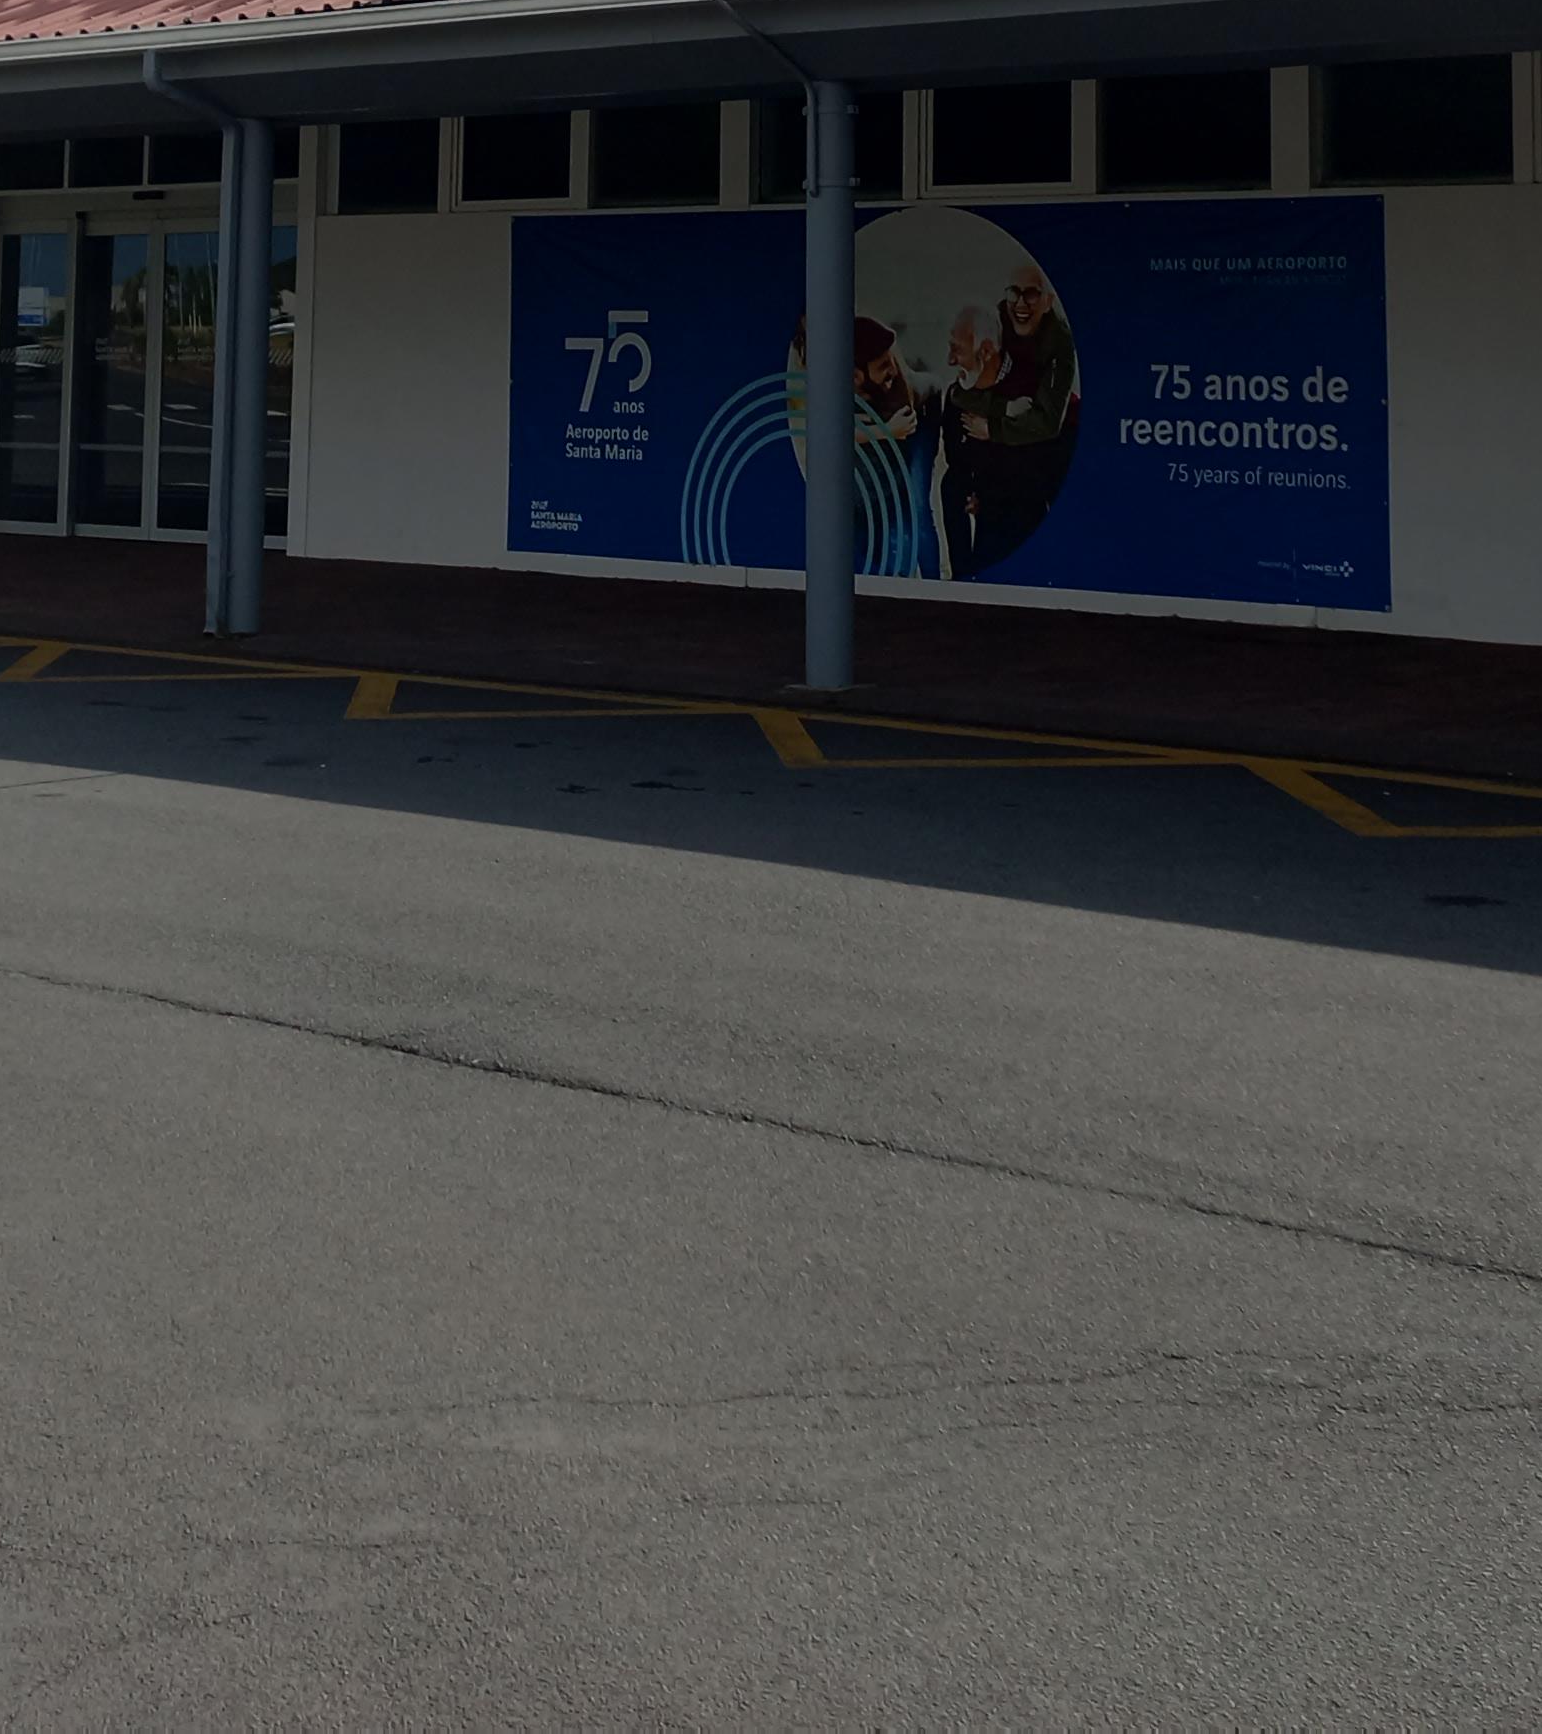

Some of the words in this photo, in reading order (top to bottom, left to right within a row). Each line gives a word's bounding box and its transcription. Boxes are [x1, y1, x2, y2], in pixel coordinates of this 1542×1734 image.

[1149, 257, 1187, 271] MAIS
[1191, 257, 1221, 272] QUE
[1226, 257, 1252, 270] UM
[1257, 255, 1348, 270] AEROPORTO
[564, 309, 652, 413] 75
[1150, 364, 1191, 400] 75
[1203, 373, 1290, 402] anos
[1301, 365, 1350, 404] de
[612, 400, 646, 414] anos
[565, 423, 630, 444] Aeroporto
[632, 425, 650, 441] de
[1119, 417, 1349, 452] reencontros.
[565, 442, 601, 459] Santa
[605, 443, 644, 461] Maria
[1167, 463, 1189, 482] 75
[1193, 466, 1240, 488] years
[1244, 466, 1262, 485] of
[1268, 468, 1352, 490] reunions.
